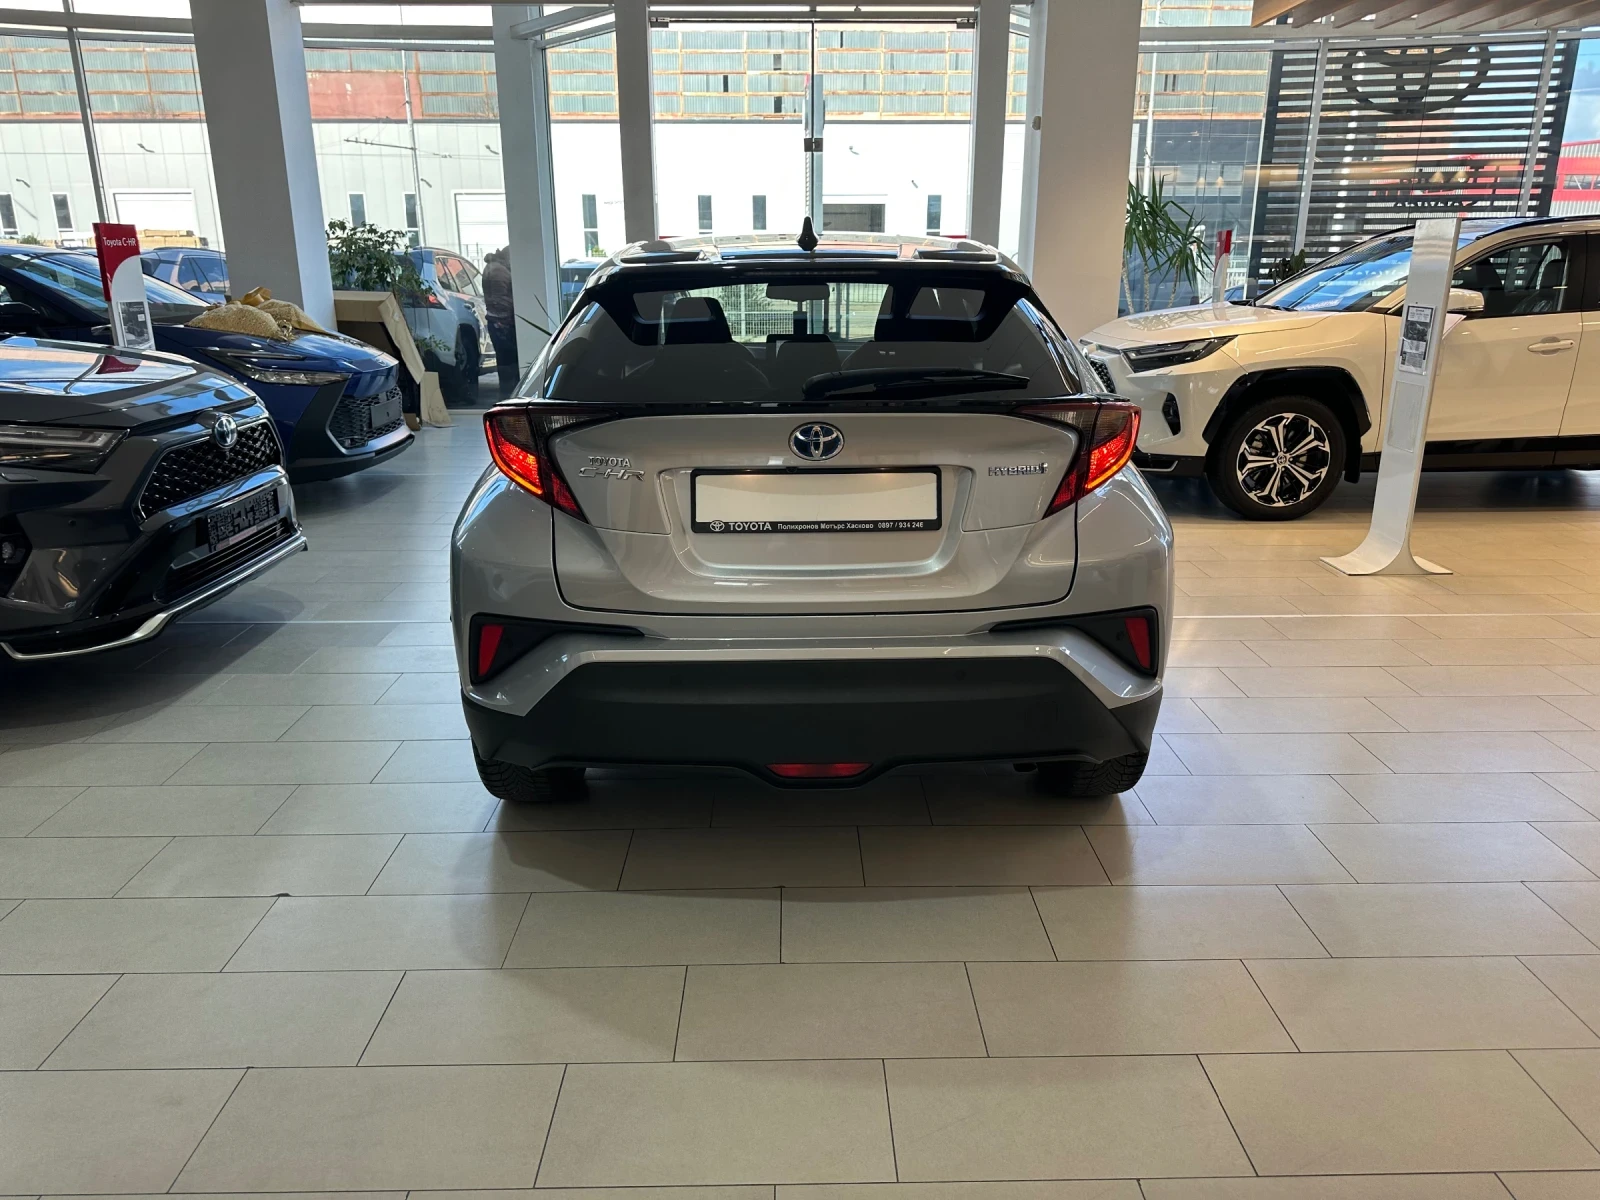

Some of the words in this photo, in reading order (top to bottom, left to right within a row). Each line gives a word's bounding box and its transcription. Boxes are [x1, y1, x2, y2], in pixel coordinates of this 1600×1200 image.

[103, 237, 121, 247] Toyota
[122, 238, 136, 246] C-HR
[588, 456, 632, 467] TOYOTA
[579, 467, 645, 480] C-HR
[988, 465, 1041, 476] HYBRID
[729, 522, 772, 531] TOYOTA
[777, 523, 819, 531] Полихронов
[820, 522, 845, 530] Мотърс
[898, 521, 911, 529] 934
